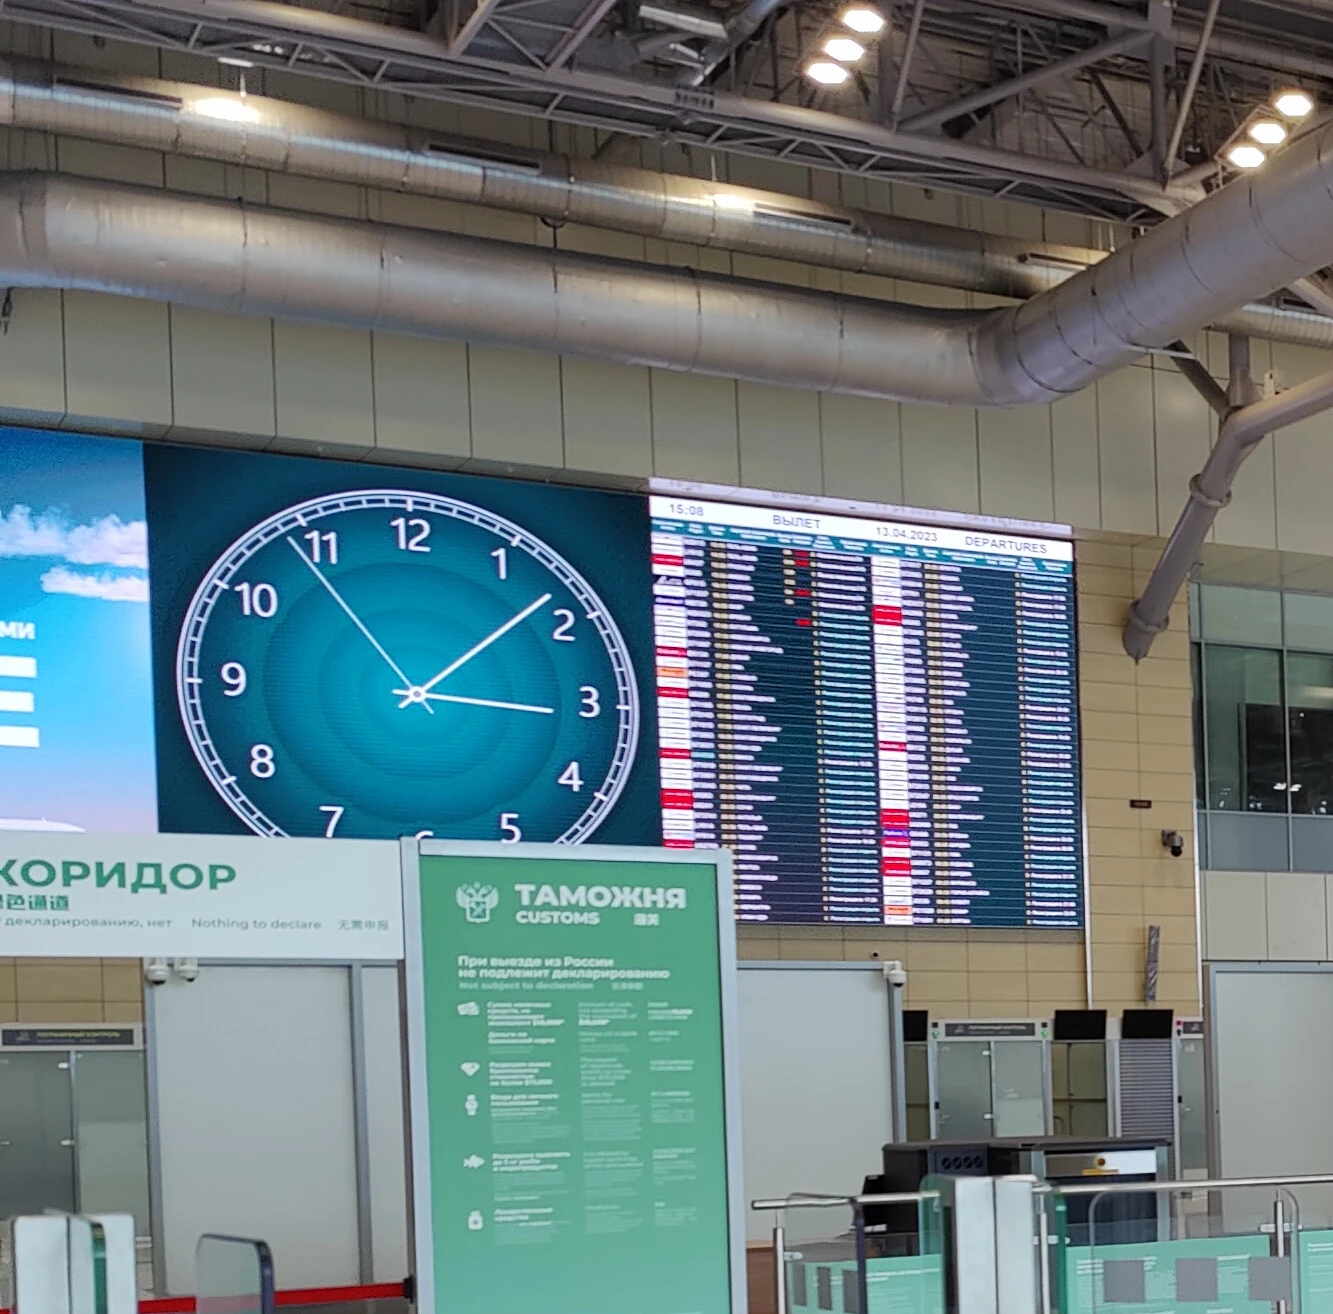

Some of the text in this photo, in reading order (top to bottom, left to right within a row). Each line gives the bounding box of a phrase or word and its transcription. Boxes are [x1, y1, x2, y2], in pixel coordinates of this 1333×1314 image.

[391, 518, 431, 552] 12
[772, 514, 821, 530] ВЫЛЕТ
[875, 526, 938, 543] 13.04.2023
[304, 532, 338, 564] 11
[965, 535, 1048, 554] DEPARTURES
[491, 548, 508, 579] 1
[235, 583, 278, 618] 10
[552, 609, 576, 641] 2
[221, 662, 246, 695] 9
[578, 686, 600, 717] 3
[250, 744, 275, 778] 8
[557, 762, 583, 792] 4
[319, 806, 345, 838] 7
[501, 814, 521, 844] 5
[0, 894, 69, 911] 色通道
[515, 884, 687, 909] ТАМОЖНЯ
[5, 917, 172, 929] декларированию, нет
[191, 918, 322, 931] Nothing to declare
[515, 910, 600, 925] CUSTOMS
[458, 956, 614, 969] При выезде из России
[458, 969, 476, 978] не
[479, 969, 549, 980] подлежит
